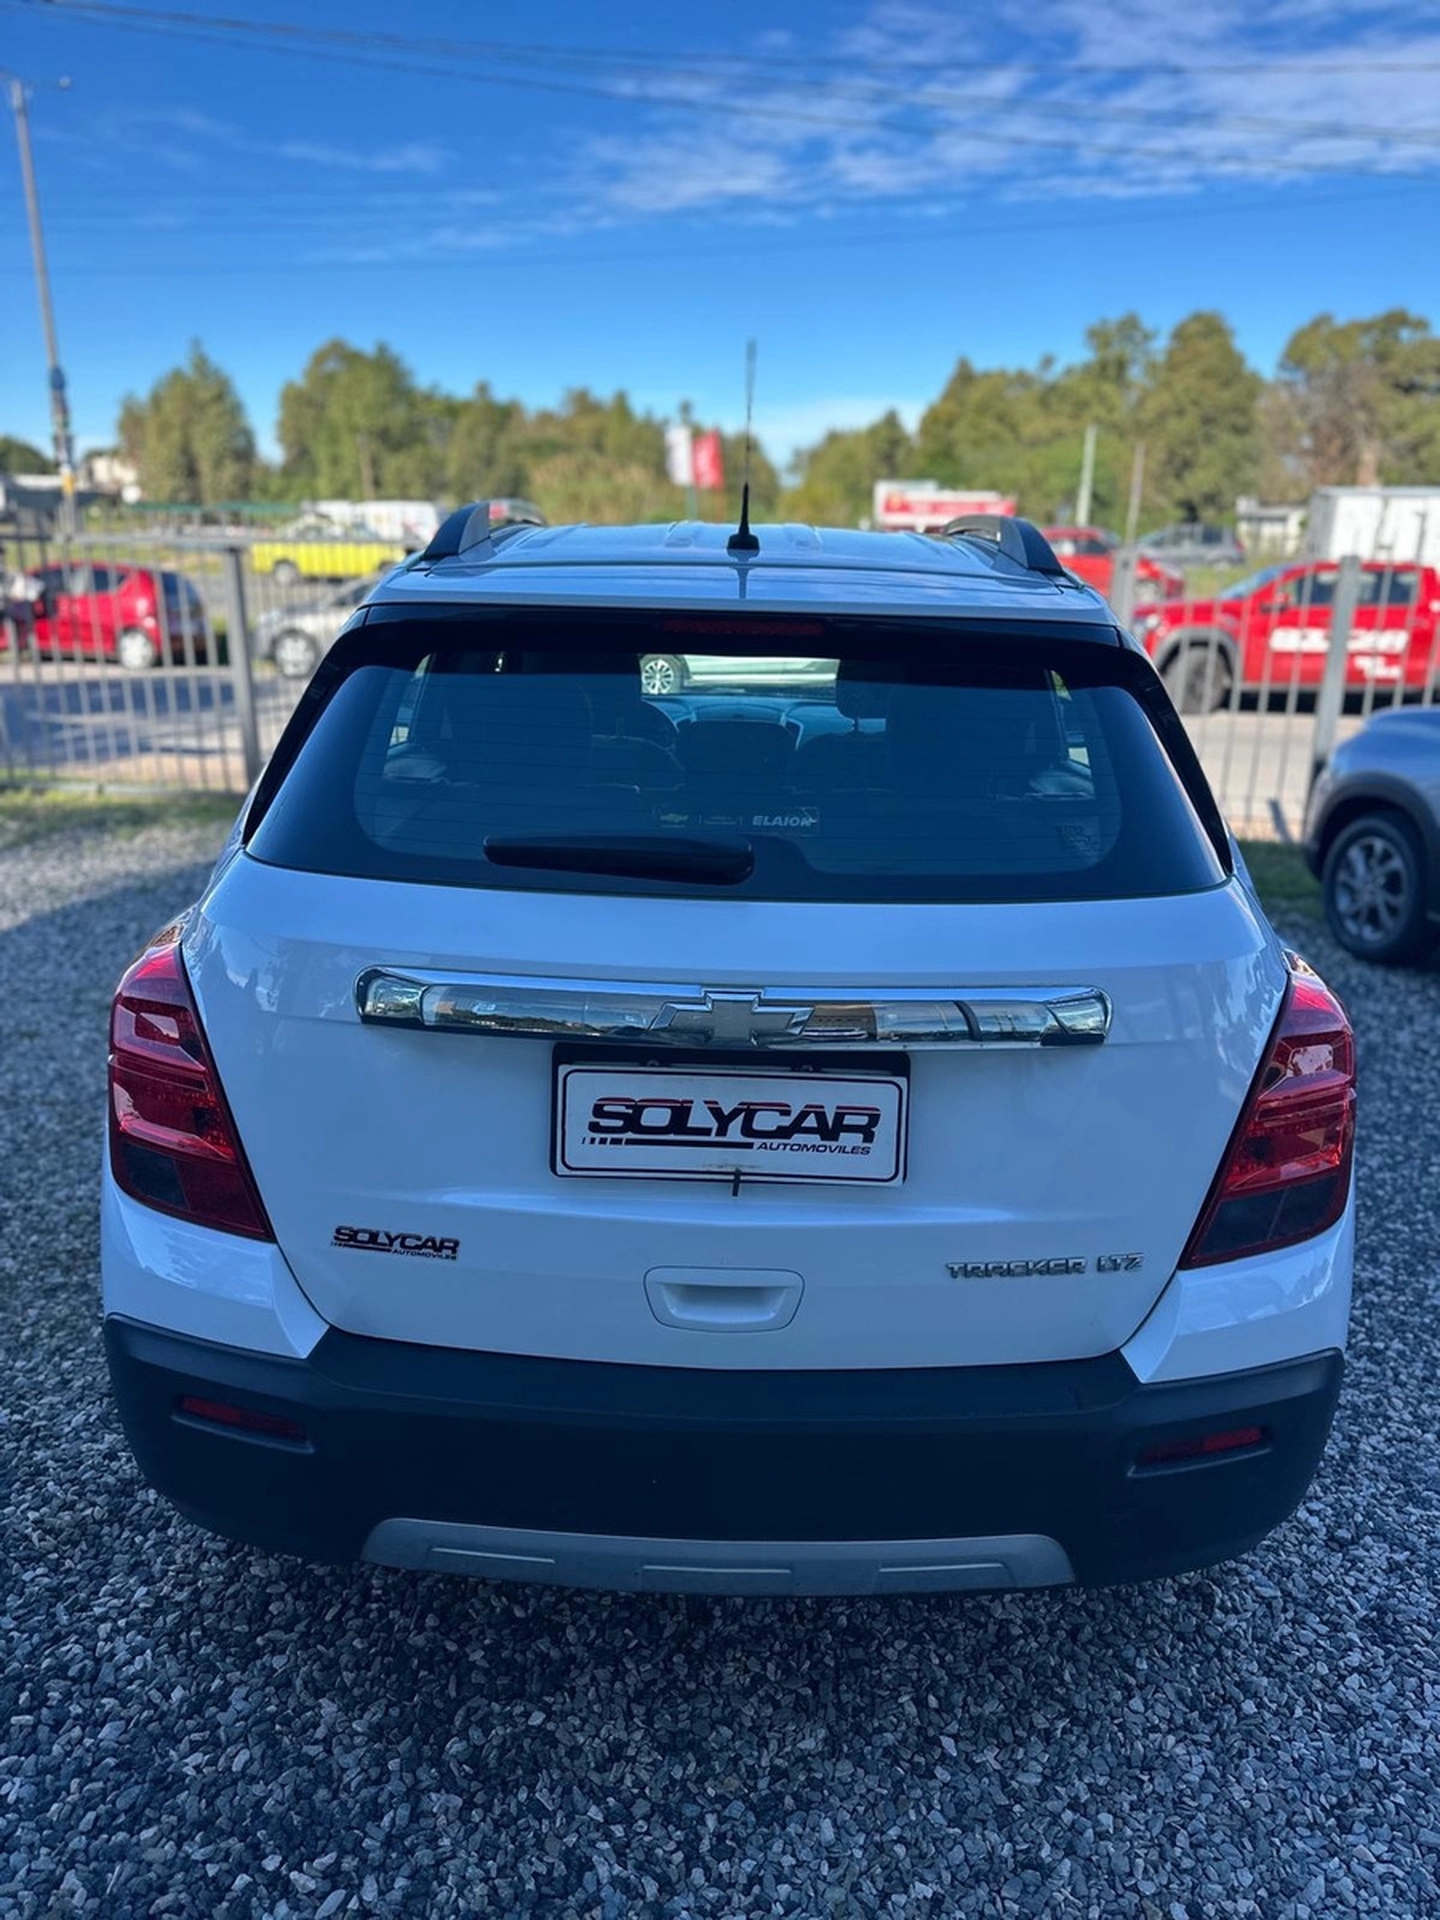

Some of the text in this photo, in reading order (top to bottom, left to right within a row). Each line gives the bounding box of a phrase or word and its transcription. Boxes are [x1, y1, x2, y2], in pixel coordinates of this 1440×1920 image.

[588, 1097, 881, 1144] SOLYCAR
[756, 1142, 871, 1156] AUTOMOVILES
[333, 1225, 460, 1255] SOLYCAR
[391, 1248, 457, 1261] AUTOMOVILES
[946, 1252, 1144, 1279] TRACKER LTZ
